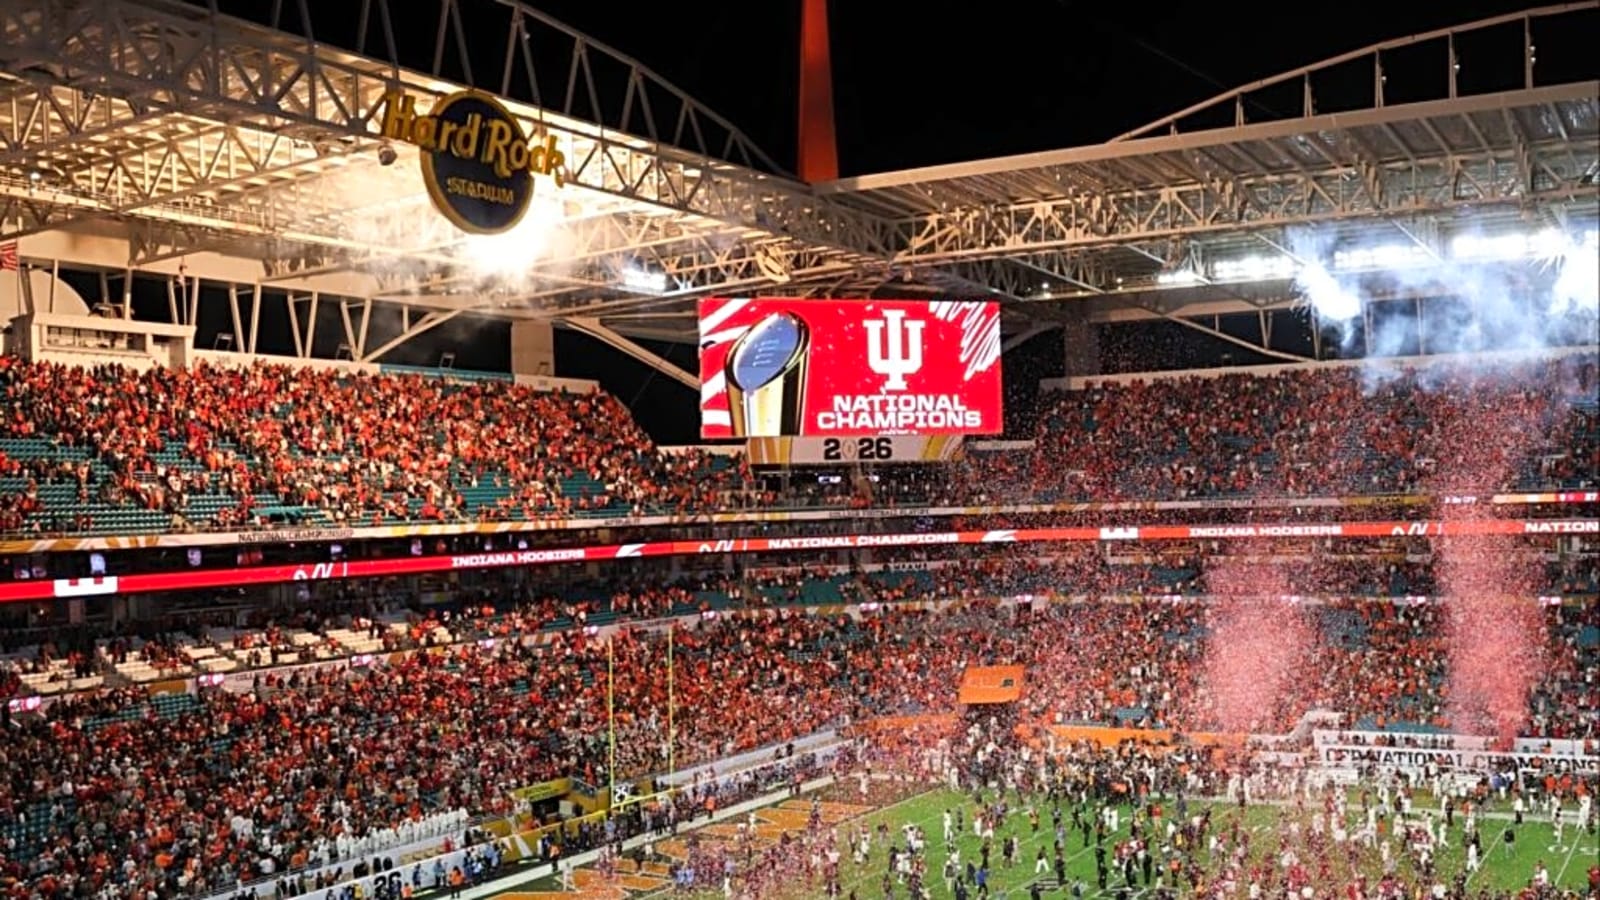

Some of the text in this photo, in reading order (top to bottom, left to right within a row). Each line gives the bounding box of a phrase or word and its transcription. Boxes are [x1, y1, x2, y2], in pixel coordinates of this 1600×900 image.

[381, 87, 566, 188] Hard Rock
[447, 177, 514, 205] STADIUM
[833, 395, 967, 412] NATIONAL
[817, 411, 982, 429] CHAMPIONS
[1189, 525, 1343, 537] INDIANA HOOSIERS
[1524, 521, 1599, 533] NATION
[768, 532, 959, 550] NATIONAL CHAMPIONS
[452, 548, 585, 568] INDIANA HOOSIERS
